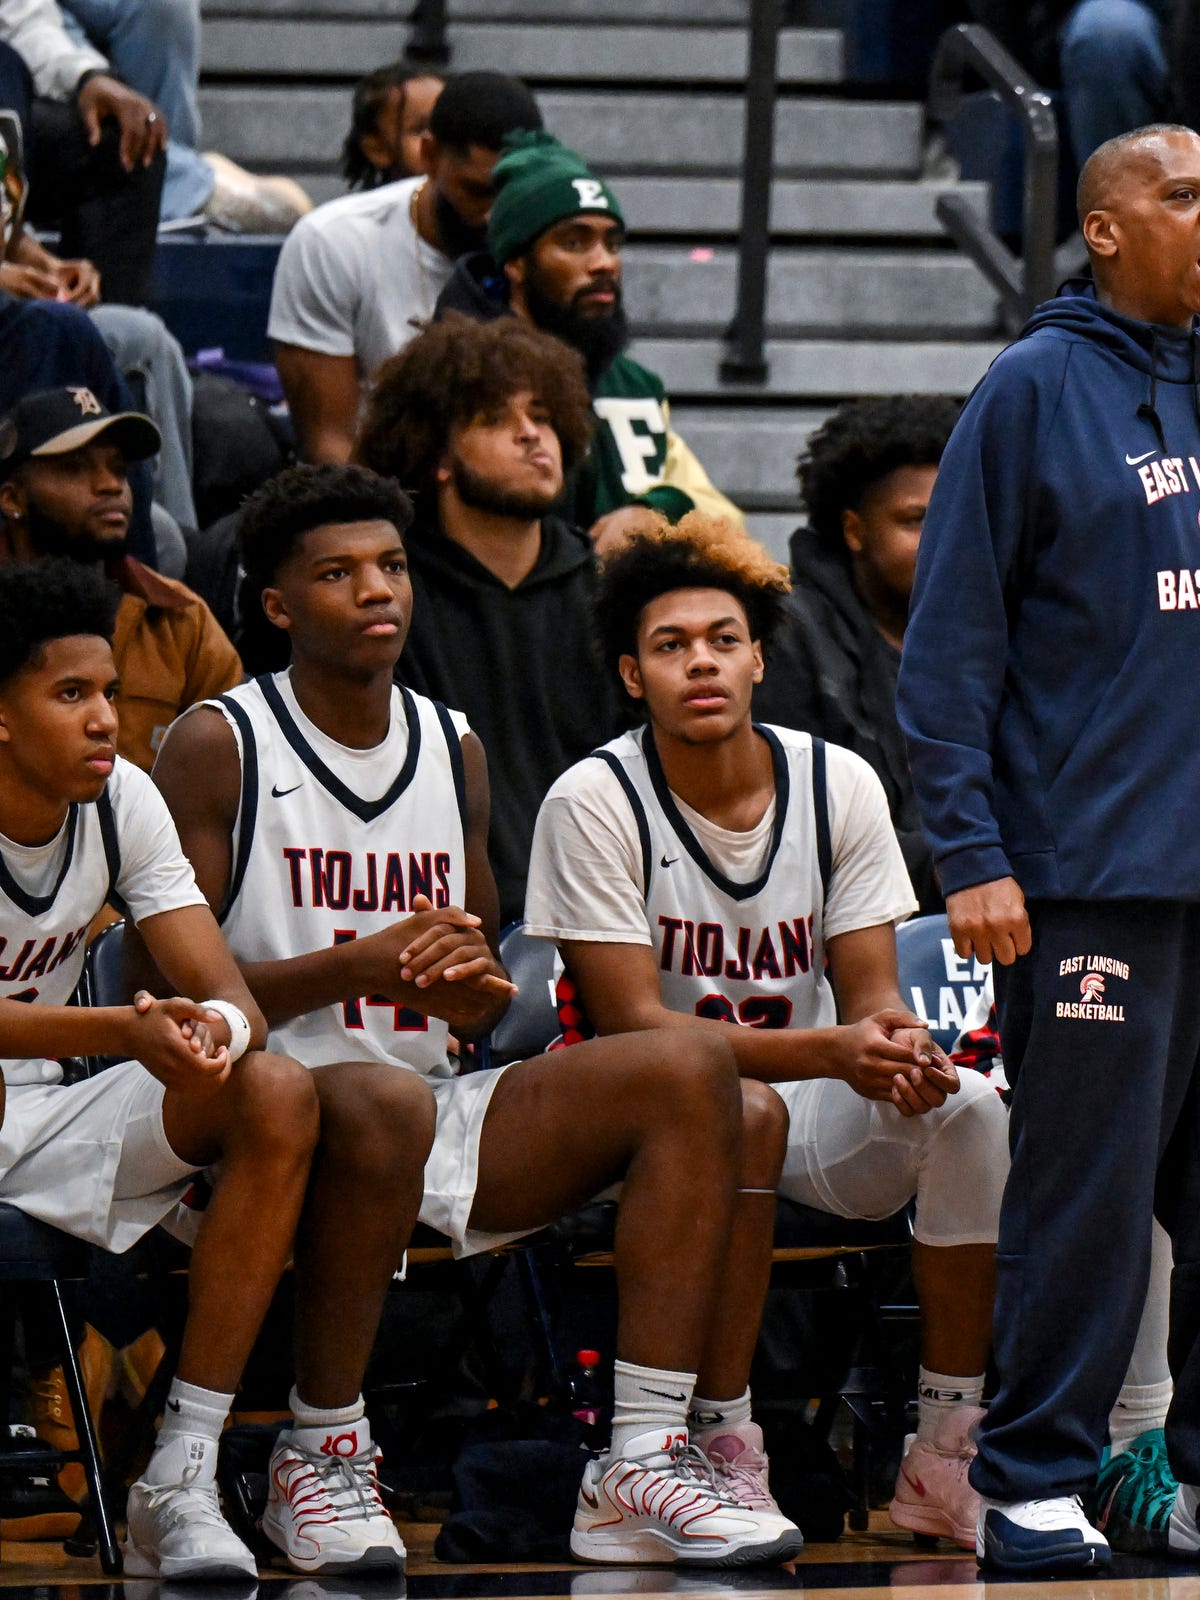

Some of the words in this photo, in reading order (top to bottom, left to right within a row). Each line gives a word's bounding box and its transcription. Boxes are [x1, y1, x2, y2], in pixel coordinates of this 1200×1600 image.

[571, 178, 608, 209] E
[1137, 457, 1189, 505] EAST
[657, 913, 814, 981] TROJAN
[1059, 955, 1085, 977] EAST
[1086, 954, 1131, 981] LANSING
[1056, 1001, 1125, 1022] BASKETBALL
